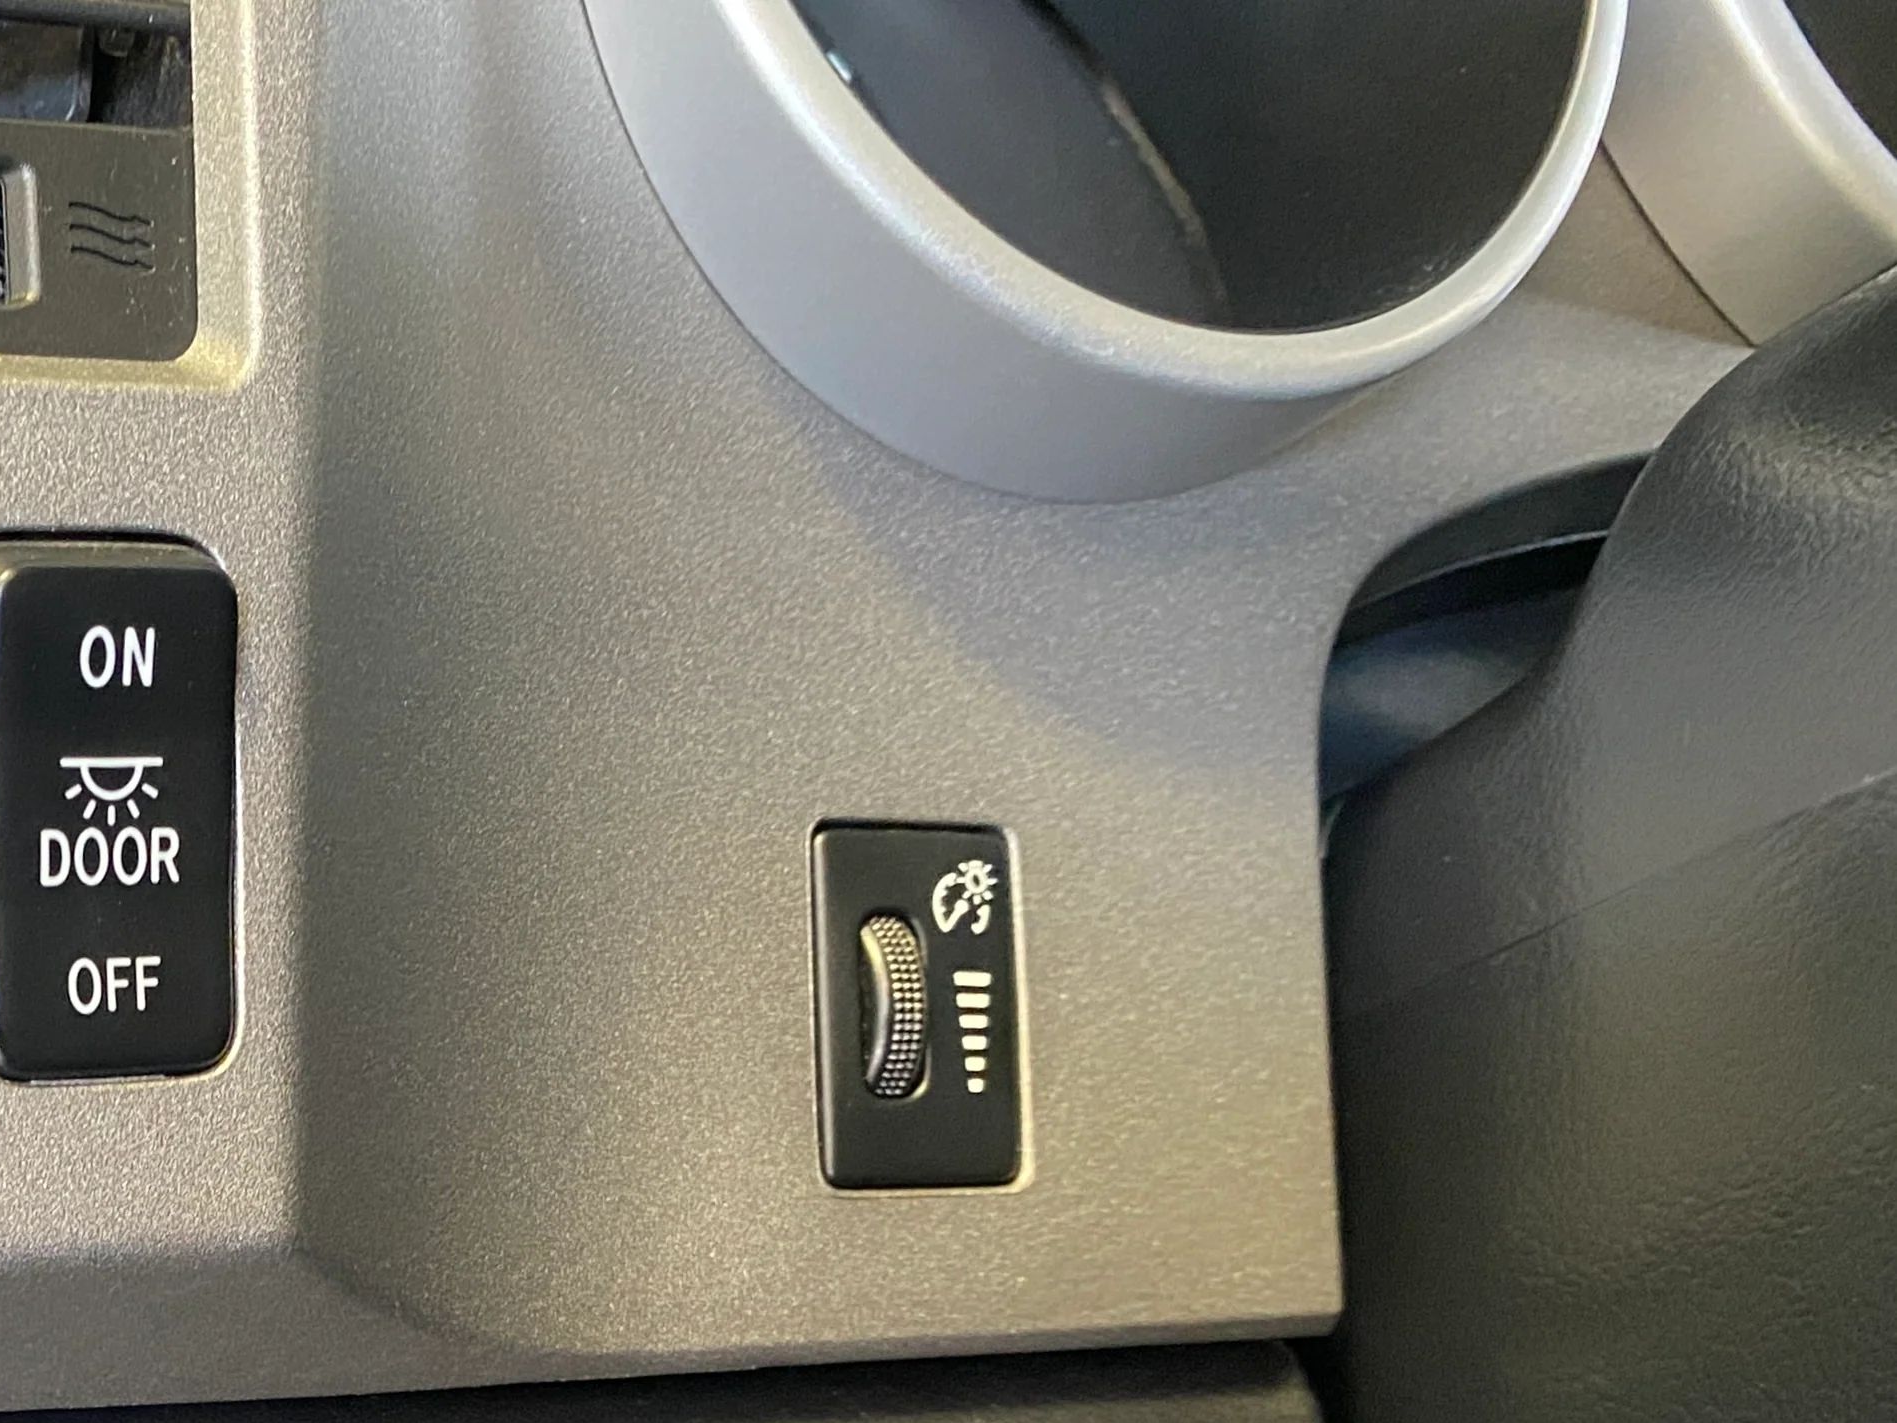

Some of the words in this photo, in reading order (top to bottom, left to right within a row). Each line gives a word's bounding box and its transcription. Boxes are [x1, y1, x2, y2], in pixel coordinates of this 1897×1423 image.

[79, 624, 156, 690] ON
[39, 825, 180, 888] DOOR
[67, 955, 162, 1015] OFF
